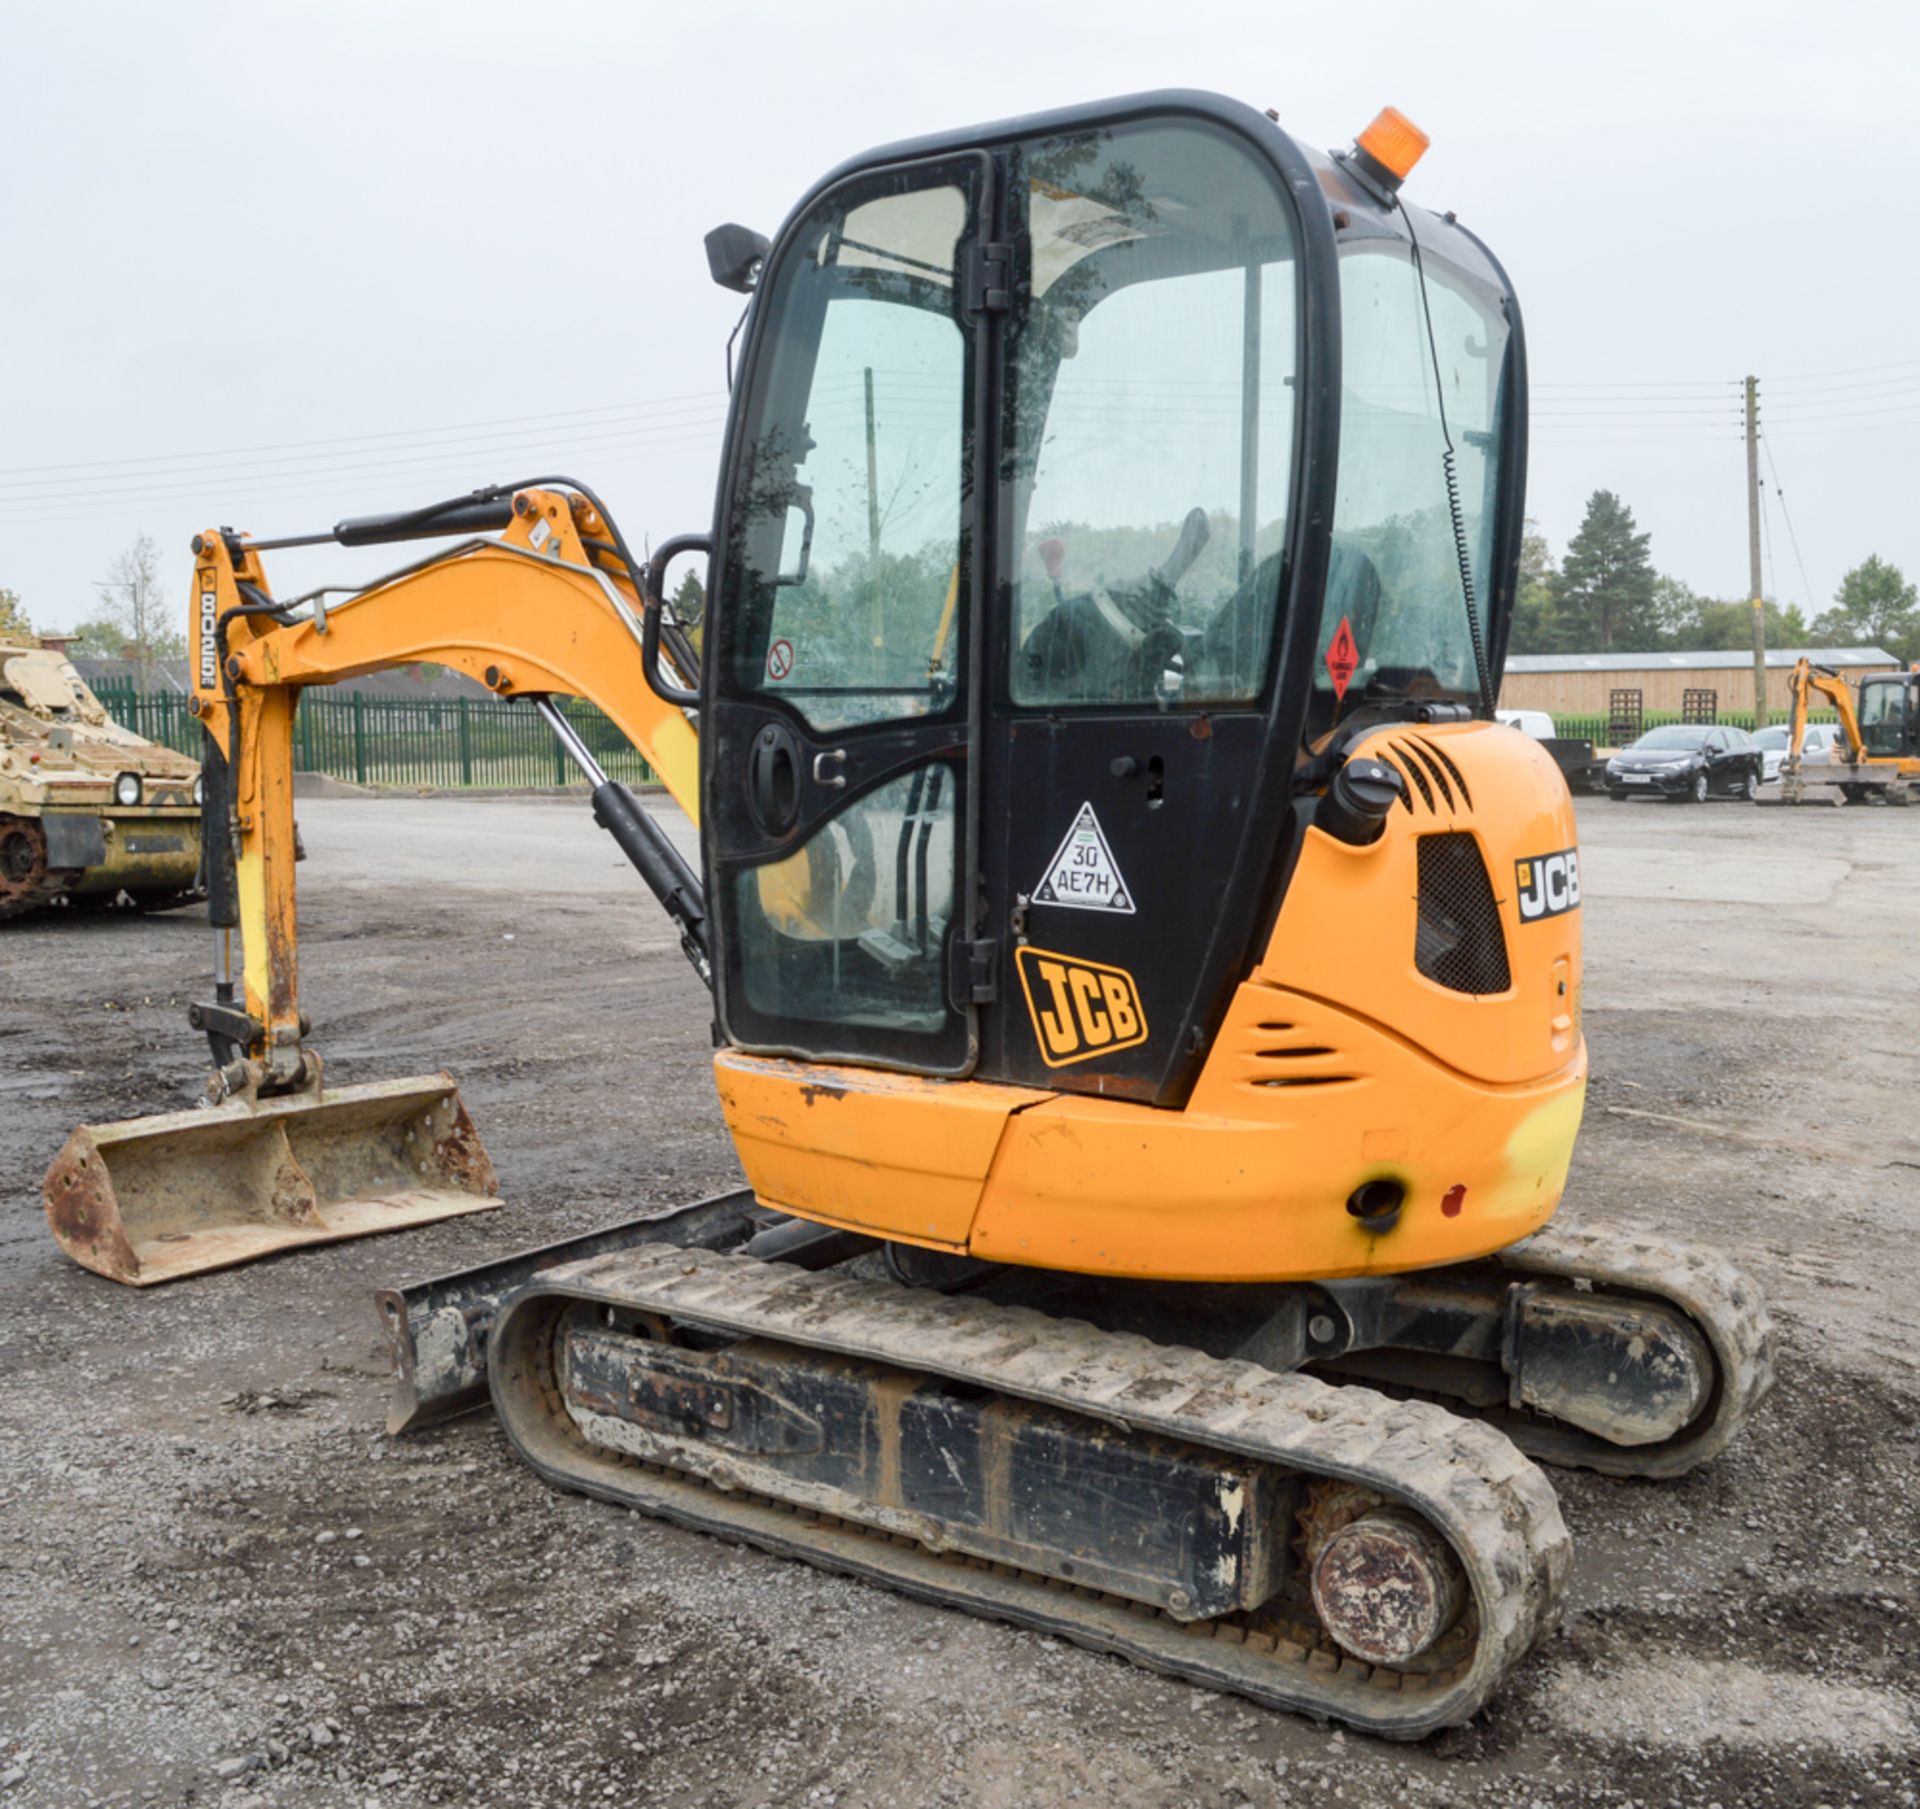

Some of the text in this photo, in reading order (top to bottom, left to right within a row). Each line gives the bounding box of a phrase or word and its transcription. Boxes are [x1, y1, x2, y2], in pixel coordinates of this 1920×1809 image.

[201, 592, 216, 677] 8025
[1057, 870, 1110, 895] AE7H
[1073, 844, 1098, 867] 30
[1519, 852, 1581, 917] JCB
[1038, 960, 1139, 1054] JCB
